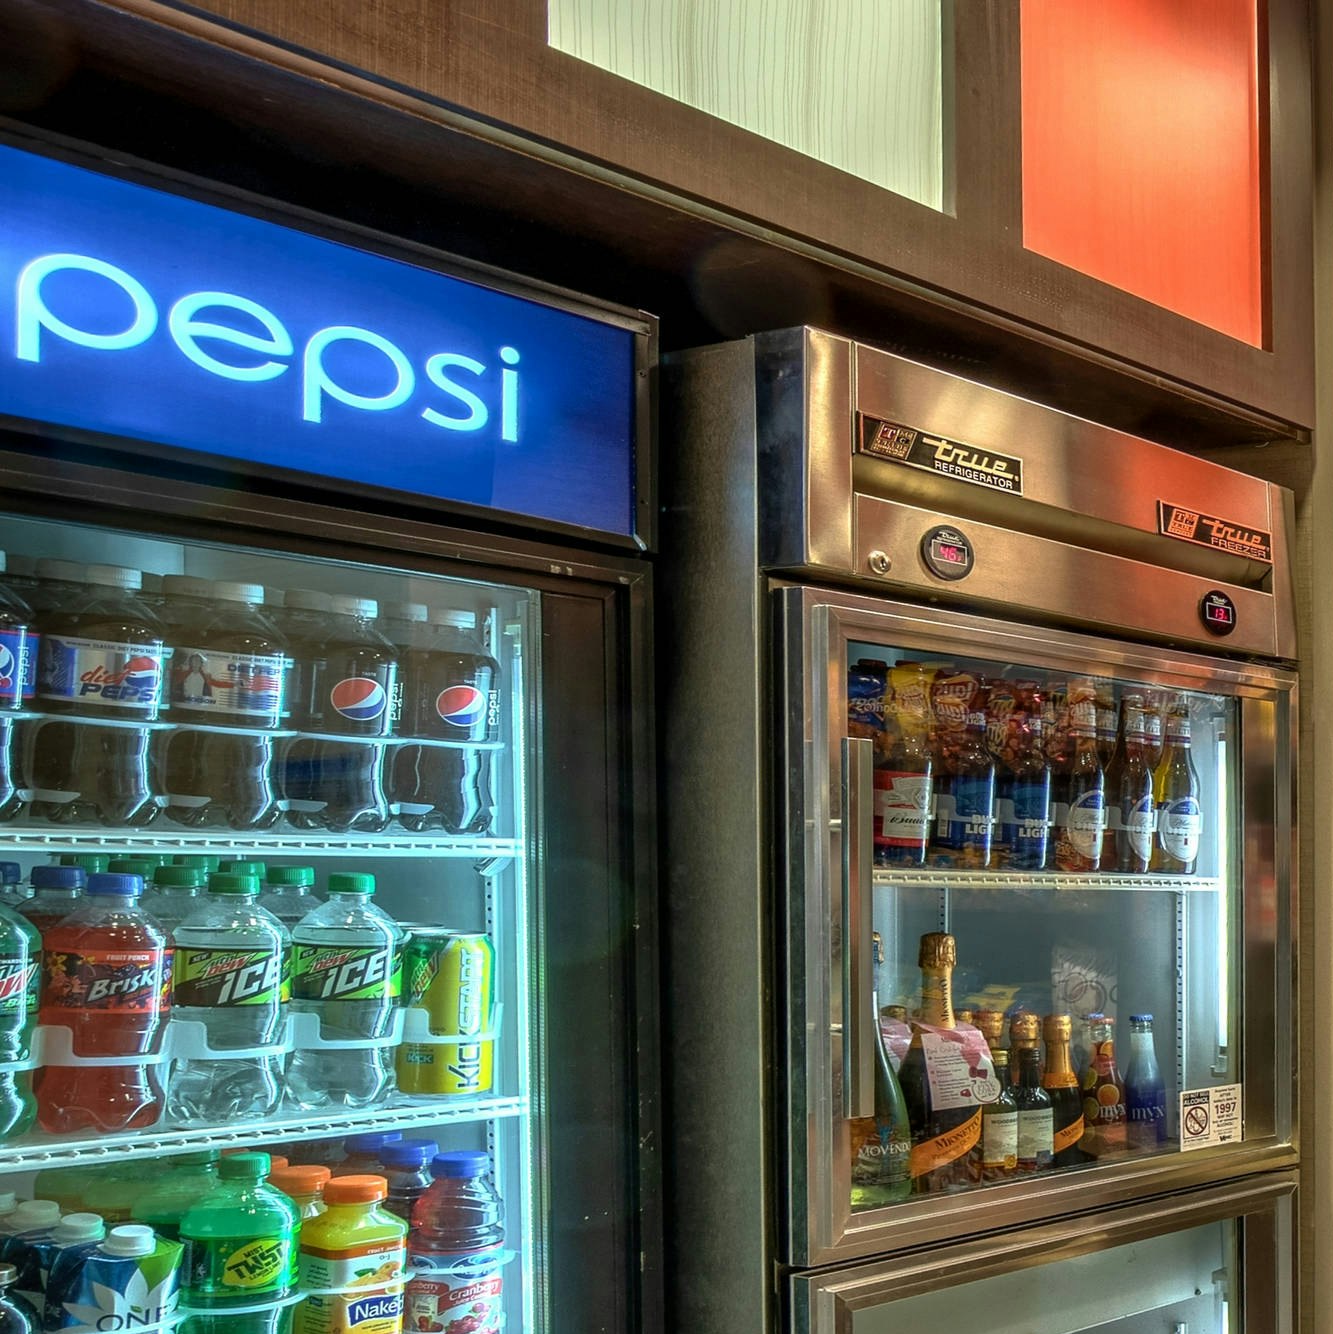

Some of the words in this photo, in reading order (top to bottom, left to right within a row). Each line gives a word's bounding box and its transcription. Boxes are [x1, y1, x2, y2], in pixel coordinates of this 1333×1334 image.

[16, 253, 522, 443] pepsi
[921, 438, 1015, 480] true
[934, 460, 1014, 490] REFRIGERATOR
[1202, 519, 1267, 550] true
[1211, 536, 1267, 559] FREEZER
[88, 968, 157, 1002] Brisk
[321, 952, 386, 998] ICE
[1214, 1101, 1238, 1115] 1997
